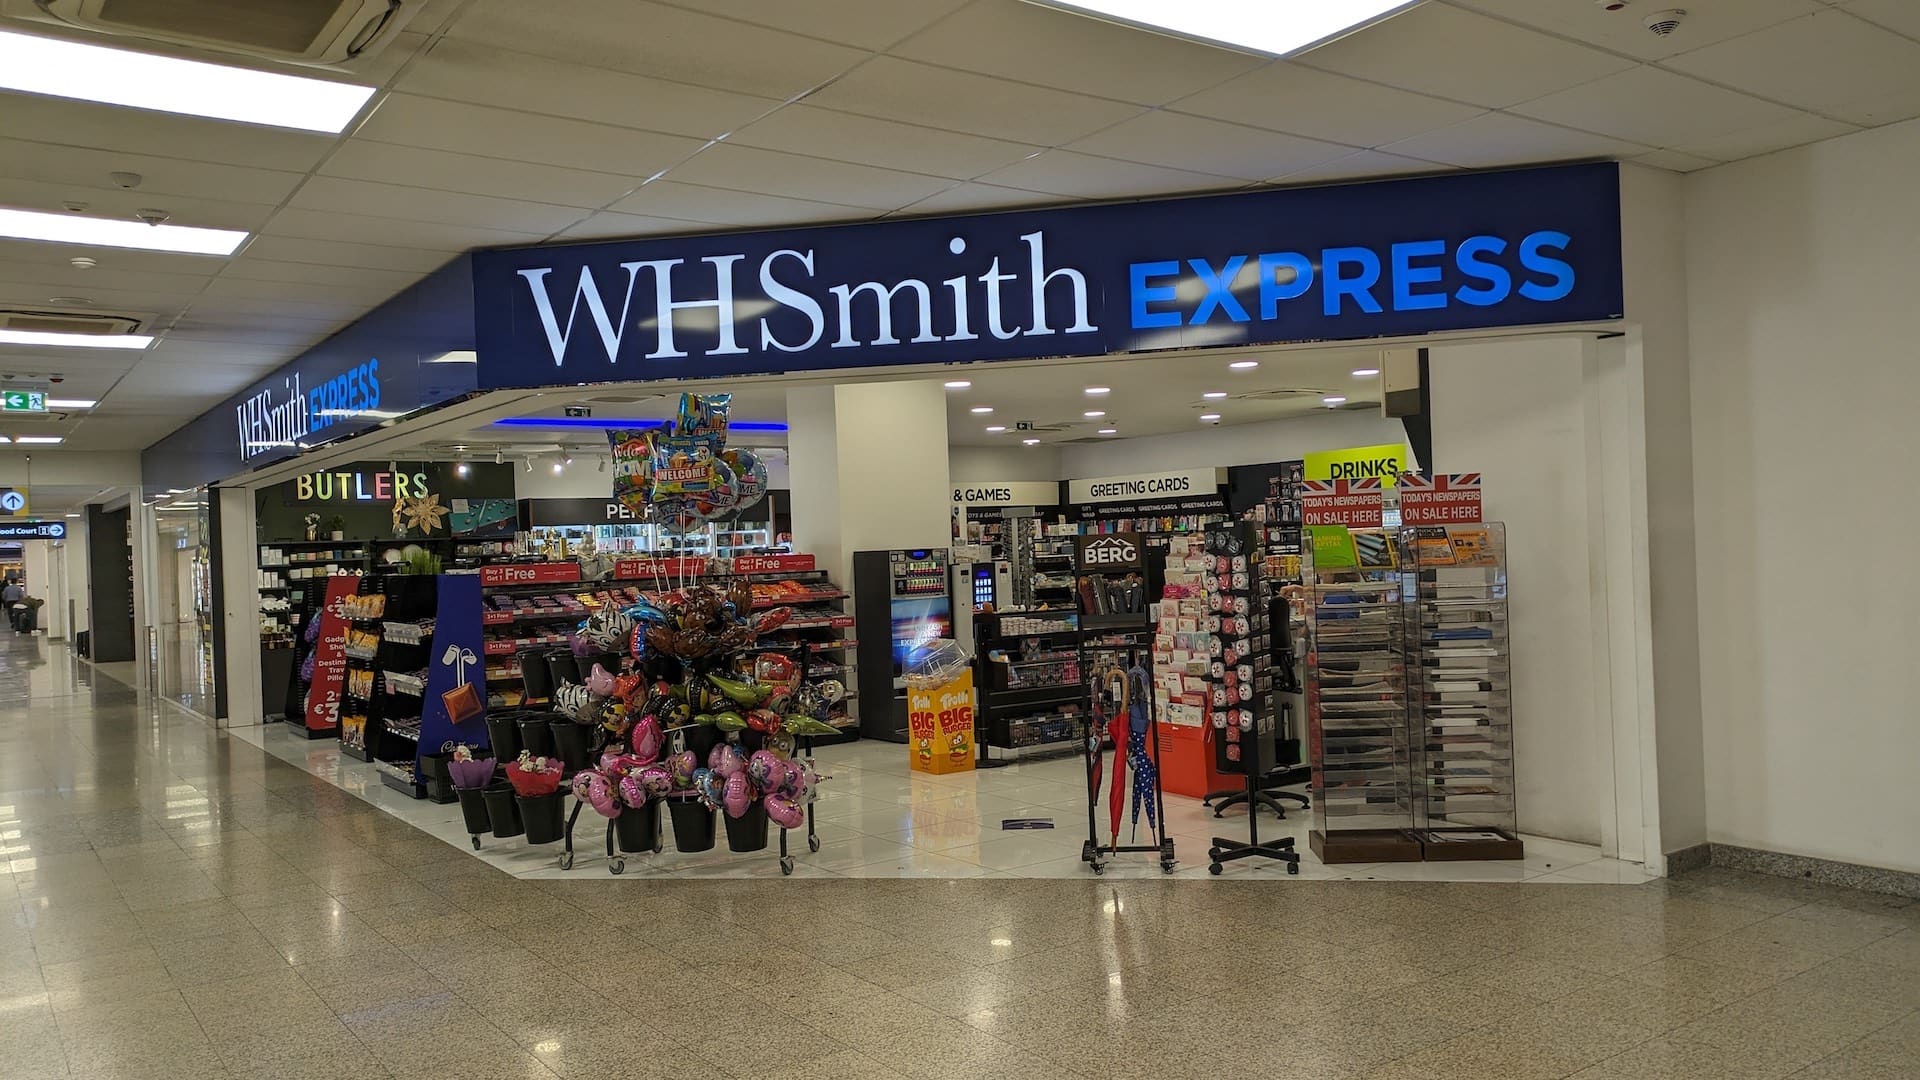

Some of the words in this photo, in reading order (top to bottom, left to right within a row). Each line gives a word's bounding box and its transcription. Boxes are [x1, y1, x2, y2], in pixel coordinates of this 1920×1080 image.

[517, 231, 1098, 367] WHSmith
[1130, 230, 1575, 329] EXPRESS
[237, 371, 308, 461] WHSmith
[309, 357, 380, 433] EXPRESS
[658, 467, 706, 482] WELCOME
[1330, 458, 1398, 479] DRINKS
[297, 472, 428, 500] BUTLERS
[1090, 481, 1146, 497] GREETING
[1148, 477, 1189, 493] CARDS
[954, 489, 963, 502] &
[965, 488, 1011, 501] GAMES
[1303, 497, 1334, 507] TODAY'S
[1333, 495, 1382, 506] NEWSPAPERS
[1402, 492, 1432, 504] TODAY'S
[1432, 491, 1481, 502] NEWSPAPERS
[1305, 513, 1321, 525] ON
[1324, 511, 1350, 524] SALE
[1352, 510, 1380, 523] HERE
[1404, 508, 1420, 521] ON
[1422, 507, 1449, 520] SALE
[1451, 506, 1479, 519] HERE
[1084, 546, 1137, 564] BERG
[638, 562, 665, 575] Free
[755, 558, 780, 570] Free
[485, 568, 498, 576] Buy
[505, 568, 536, 580] Free
[940, 690, 968, 709] Trolli
[911, 711, 935, 730] BIG
[938, 706, 972, 728] BIG
[943, 723, 972, 735] BURGER
